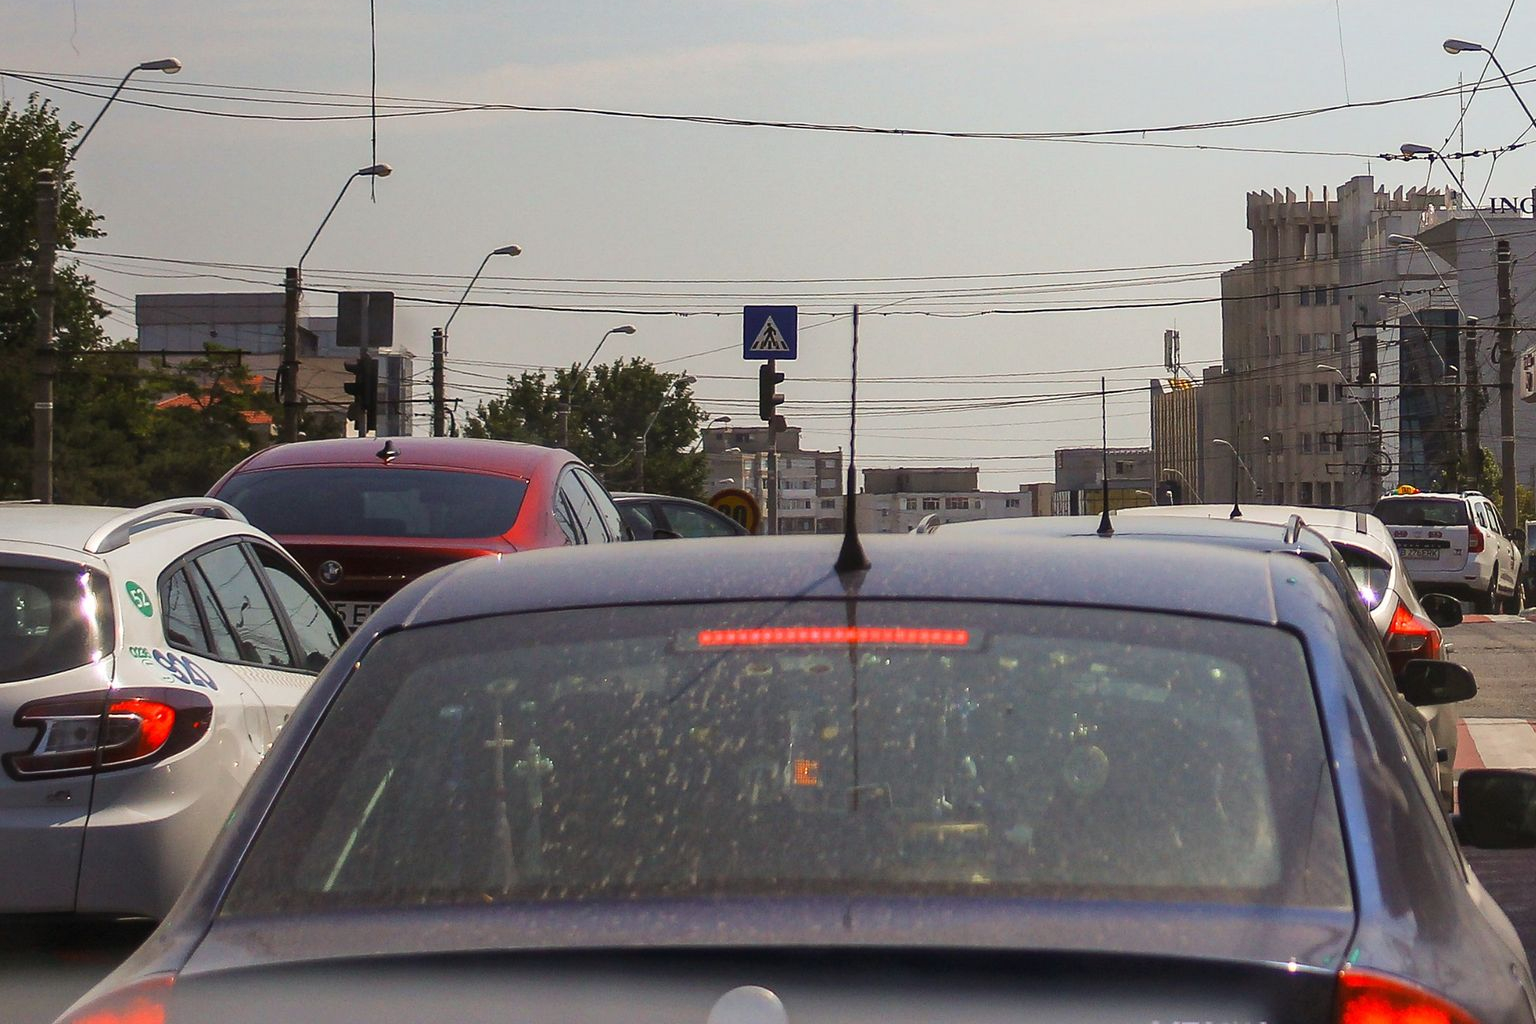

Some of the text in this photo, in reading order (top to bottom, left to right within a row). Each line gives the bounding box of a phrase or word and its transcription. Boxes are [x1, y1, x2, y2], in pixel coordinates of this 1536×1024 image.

[1489, 196, 1535, 214] ING
[130, 588, 150, 608] 52
[152, 649, 218, 691] 920
